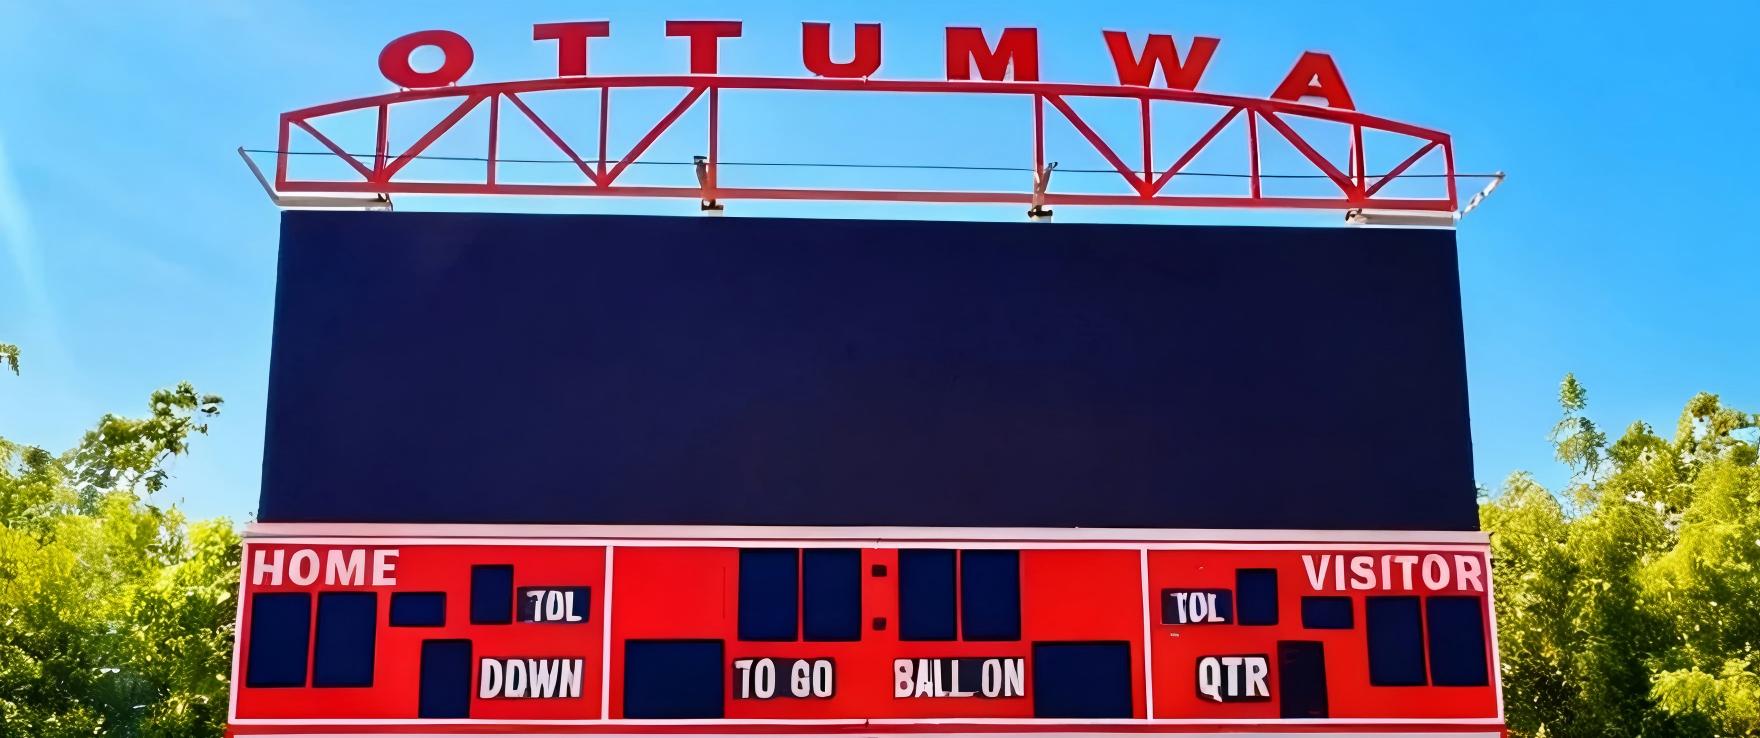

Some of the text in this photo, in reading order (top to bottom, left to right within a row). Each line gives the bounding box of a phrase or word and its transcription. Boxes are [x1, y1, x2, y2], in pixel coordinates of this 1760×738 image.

[378, 20, 1356, 111] OTTUMWA
[252, 549, 399, 586] HOME
[1301, 553, 1484, 592] VISITOR
[735, 658, 834, 699] TO GO
[894, 659, 1025, 698] BALL ON
[1198, 656, 1270, 703] QTR
